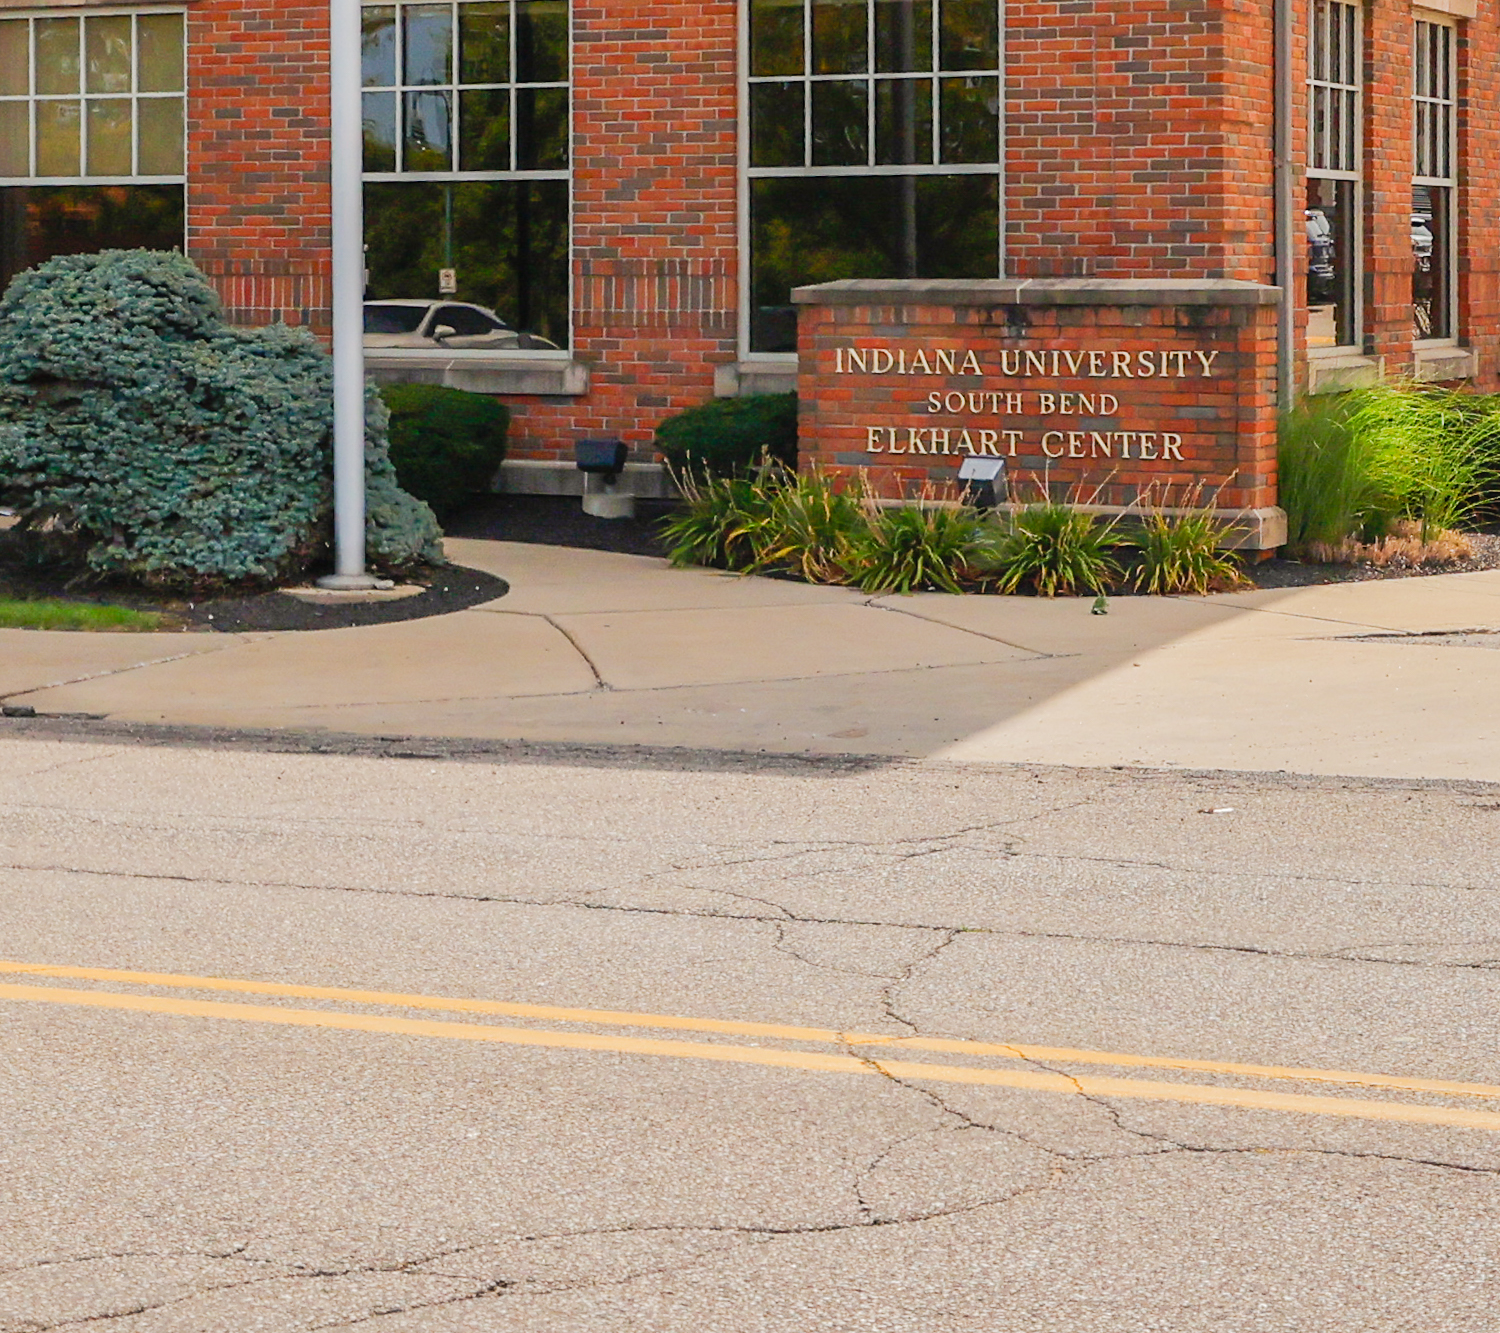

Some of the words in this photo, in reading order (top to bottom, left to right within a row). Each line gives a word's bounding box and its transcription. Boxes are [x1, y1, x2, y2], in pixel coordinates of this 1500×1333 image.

[834, 347, 983, 376] INDIANA
[1001, 349, 1219, 378] UNIVERSITY
[927, 390, 1023, 415] SOUTH
[1039, 392, 1119, 416] BEND
[866, 426, 1023, 457] ELKHART
[1042, 431, 1185, 461] CENTER
